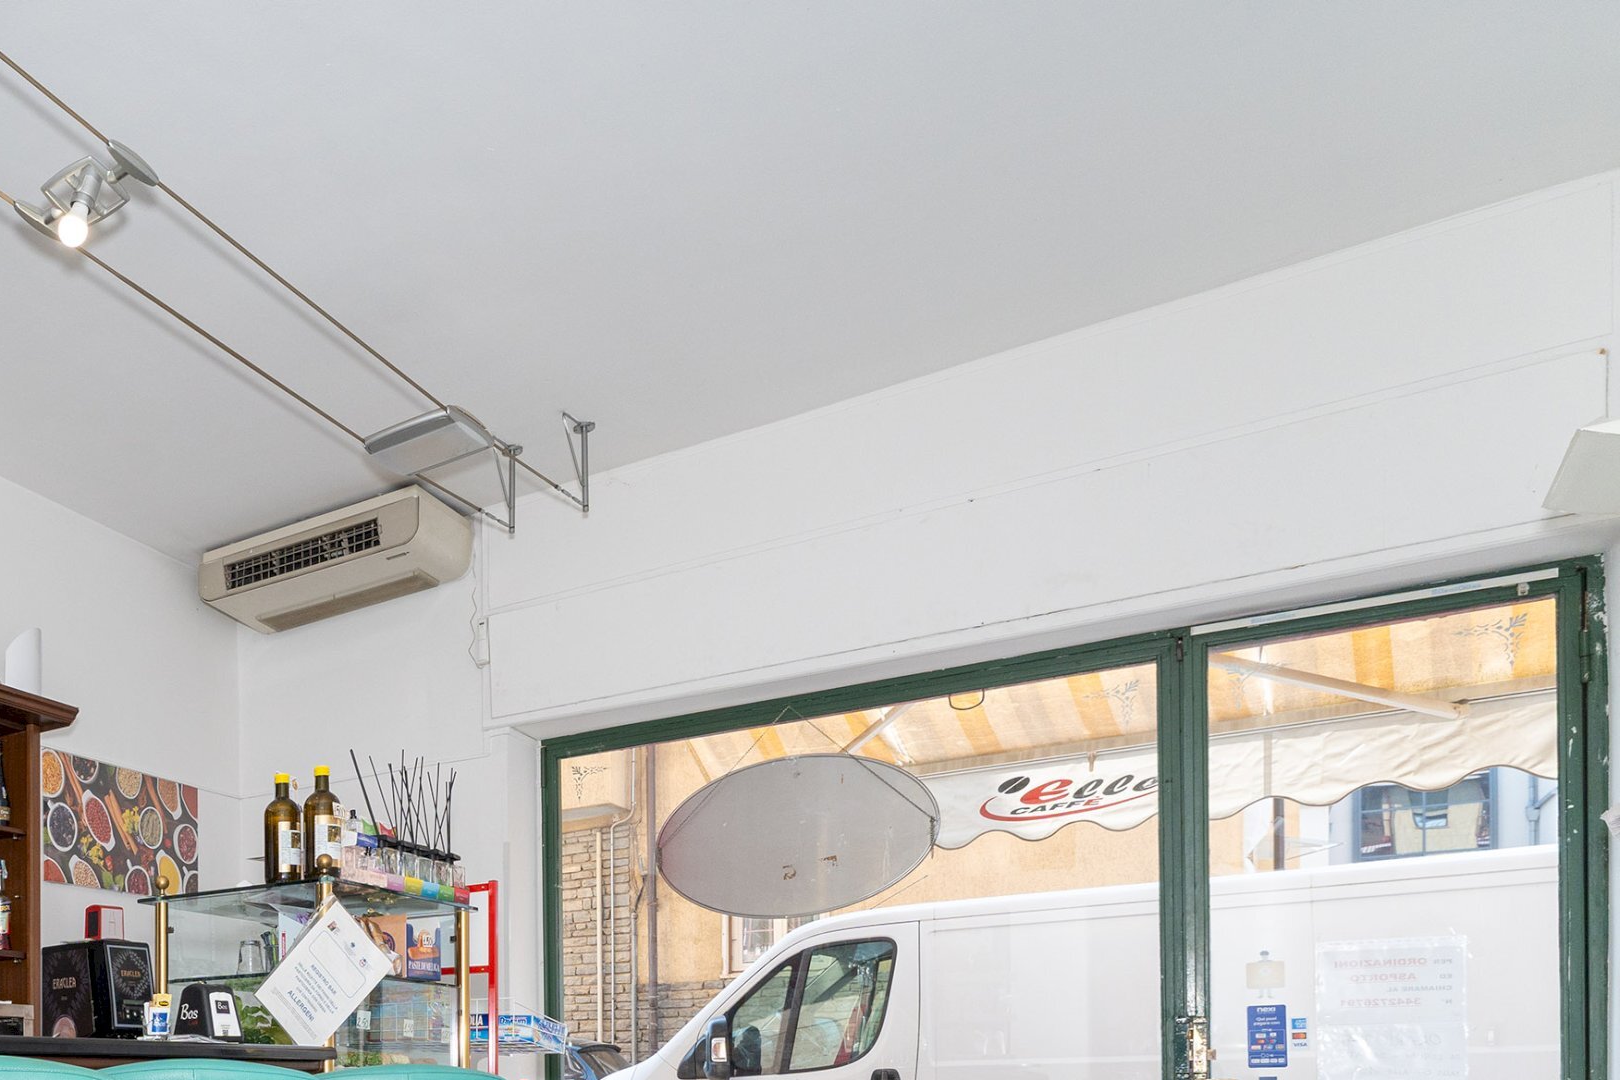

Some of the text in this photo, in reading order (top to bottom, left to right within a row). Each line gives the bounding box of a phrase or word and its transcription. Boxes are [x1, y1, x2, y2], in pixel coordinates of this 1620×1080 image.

[121, 969, 141, 978] ERACLEA
[52, 977, 77, 990] ERACLEA
[286, 989, 316, 1022] ALLERGENI
